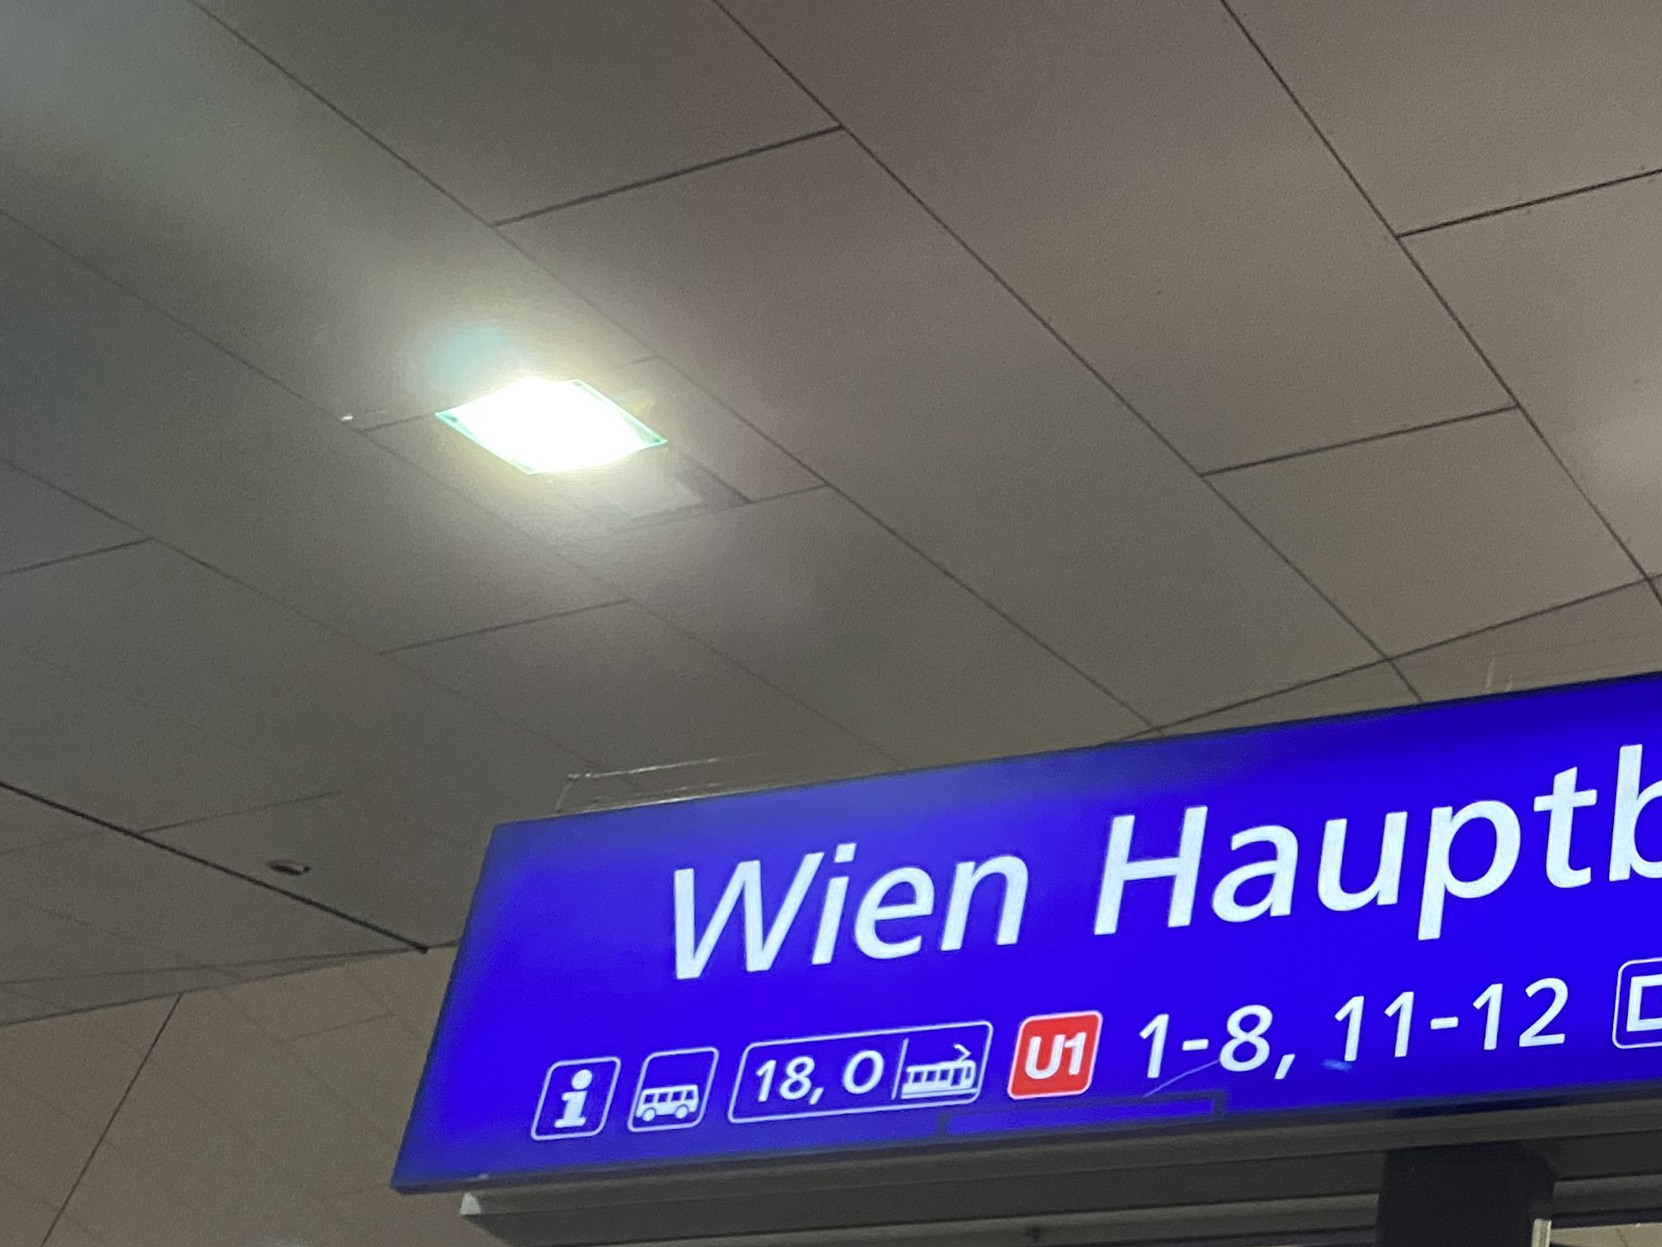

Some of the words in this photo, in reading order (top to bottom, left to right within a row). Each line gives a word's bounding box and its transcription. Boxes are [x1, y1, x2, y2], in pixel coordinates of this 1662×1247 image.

[669, 841, 1029, 980] Wien
[1023, 1030, 1086, 1081] U1
[1138, 1004, 1297, 1081] 1-8,
[1333, 977, 1570, 1062] 11-12
[754, 1056, 825, 1105] 18,
